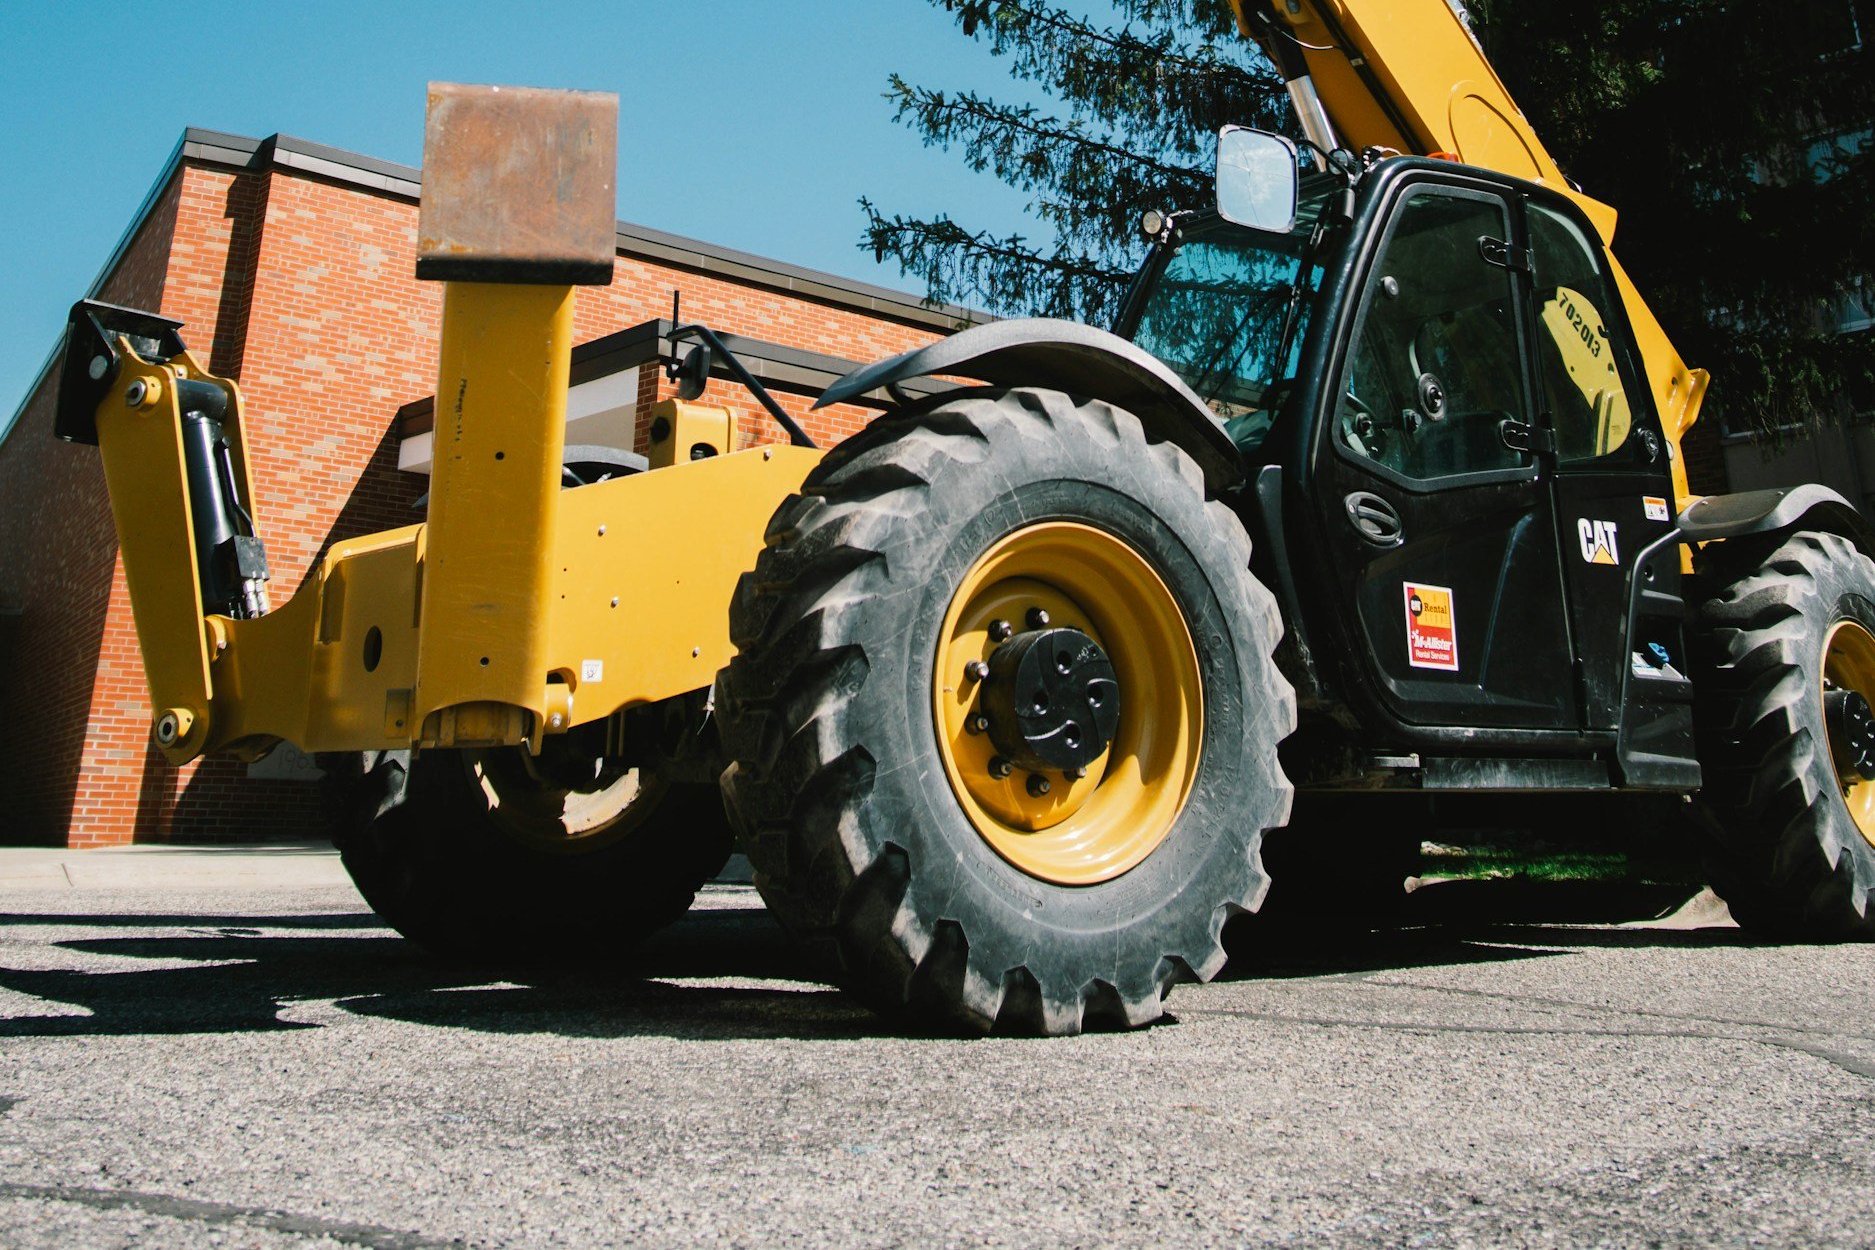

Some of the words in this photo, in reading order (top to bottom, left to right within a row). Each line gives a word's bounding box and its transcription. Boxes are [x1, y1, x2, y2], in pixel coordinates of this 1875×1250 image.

[1557, 292, 1602, 358] 702013
[1577, 517, 1620, 566] CAT
[1424, 602, 1447, 614] Rental
[1415, 650, 1430, 659] Rental
[1430, 651, 1450, 661] Services
